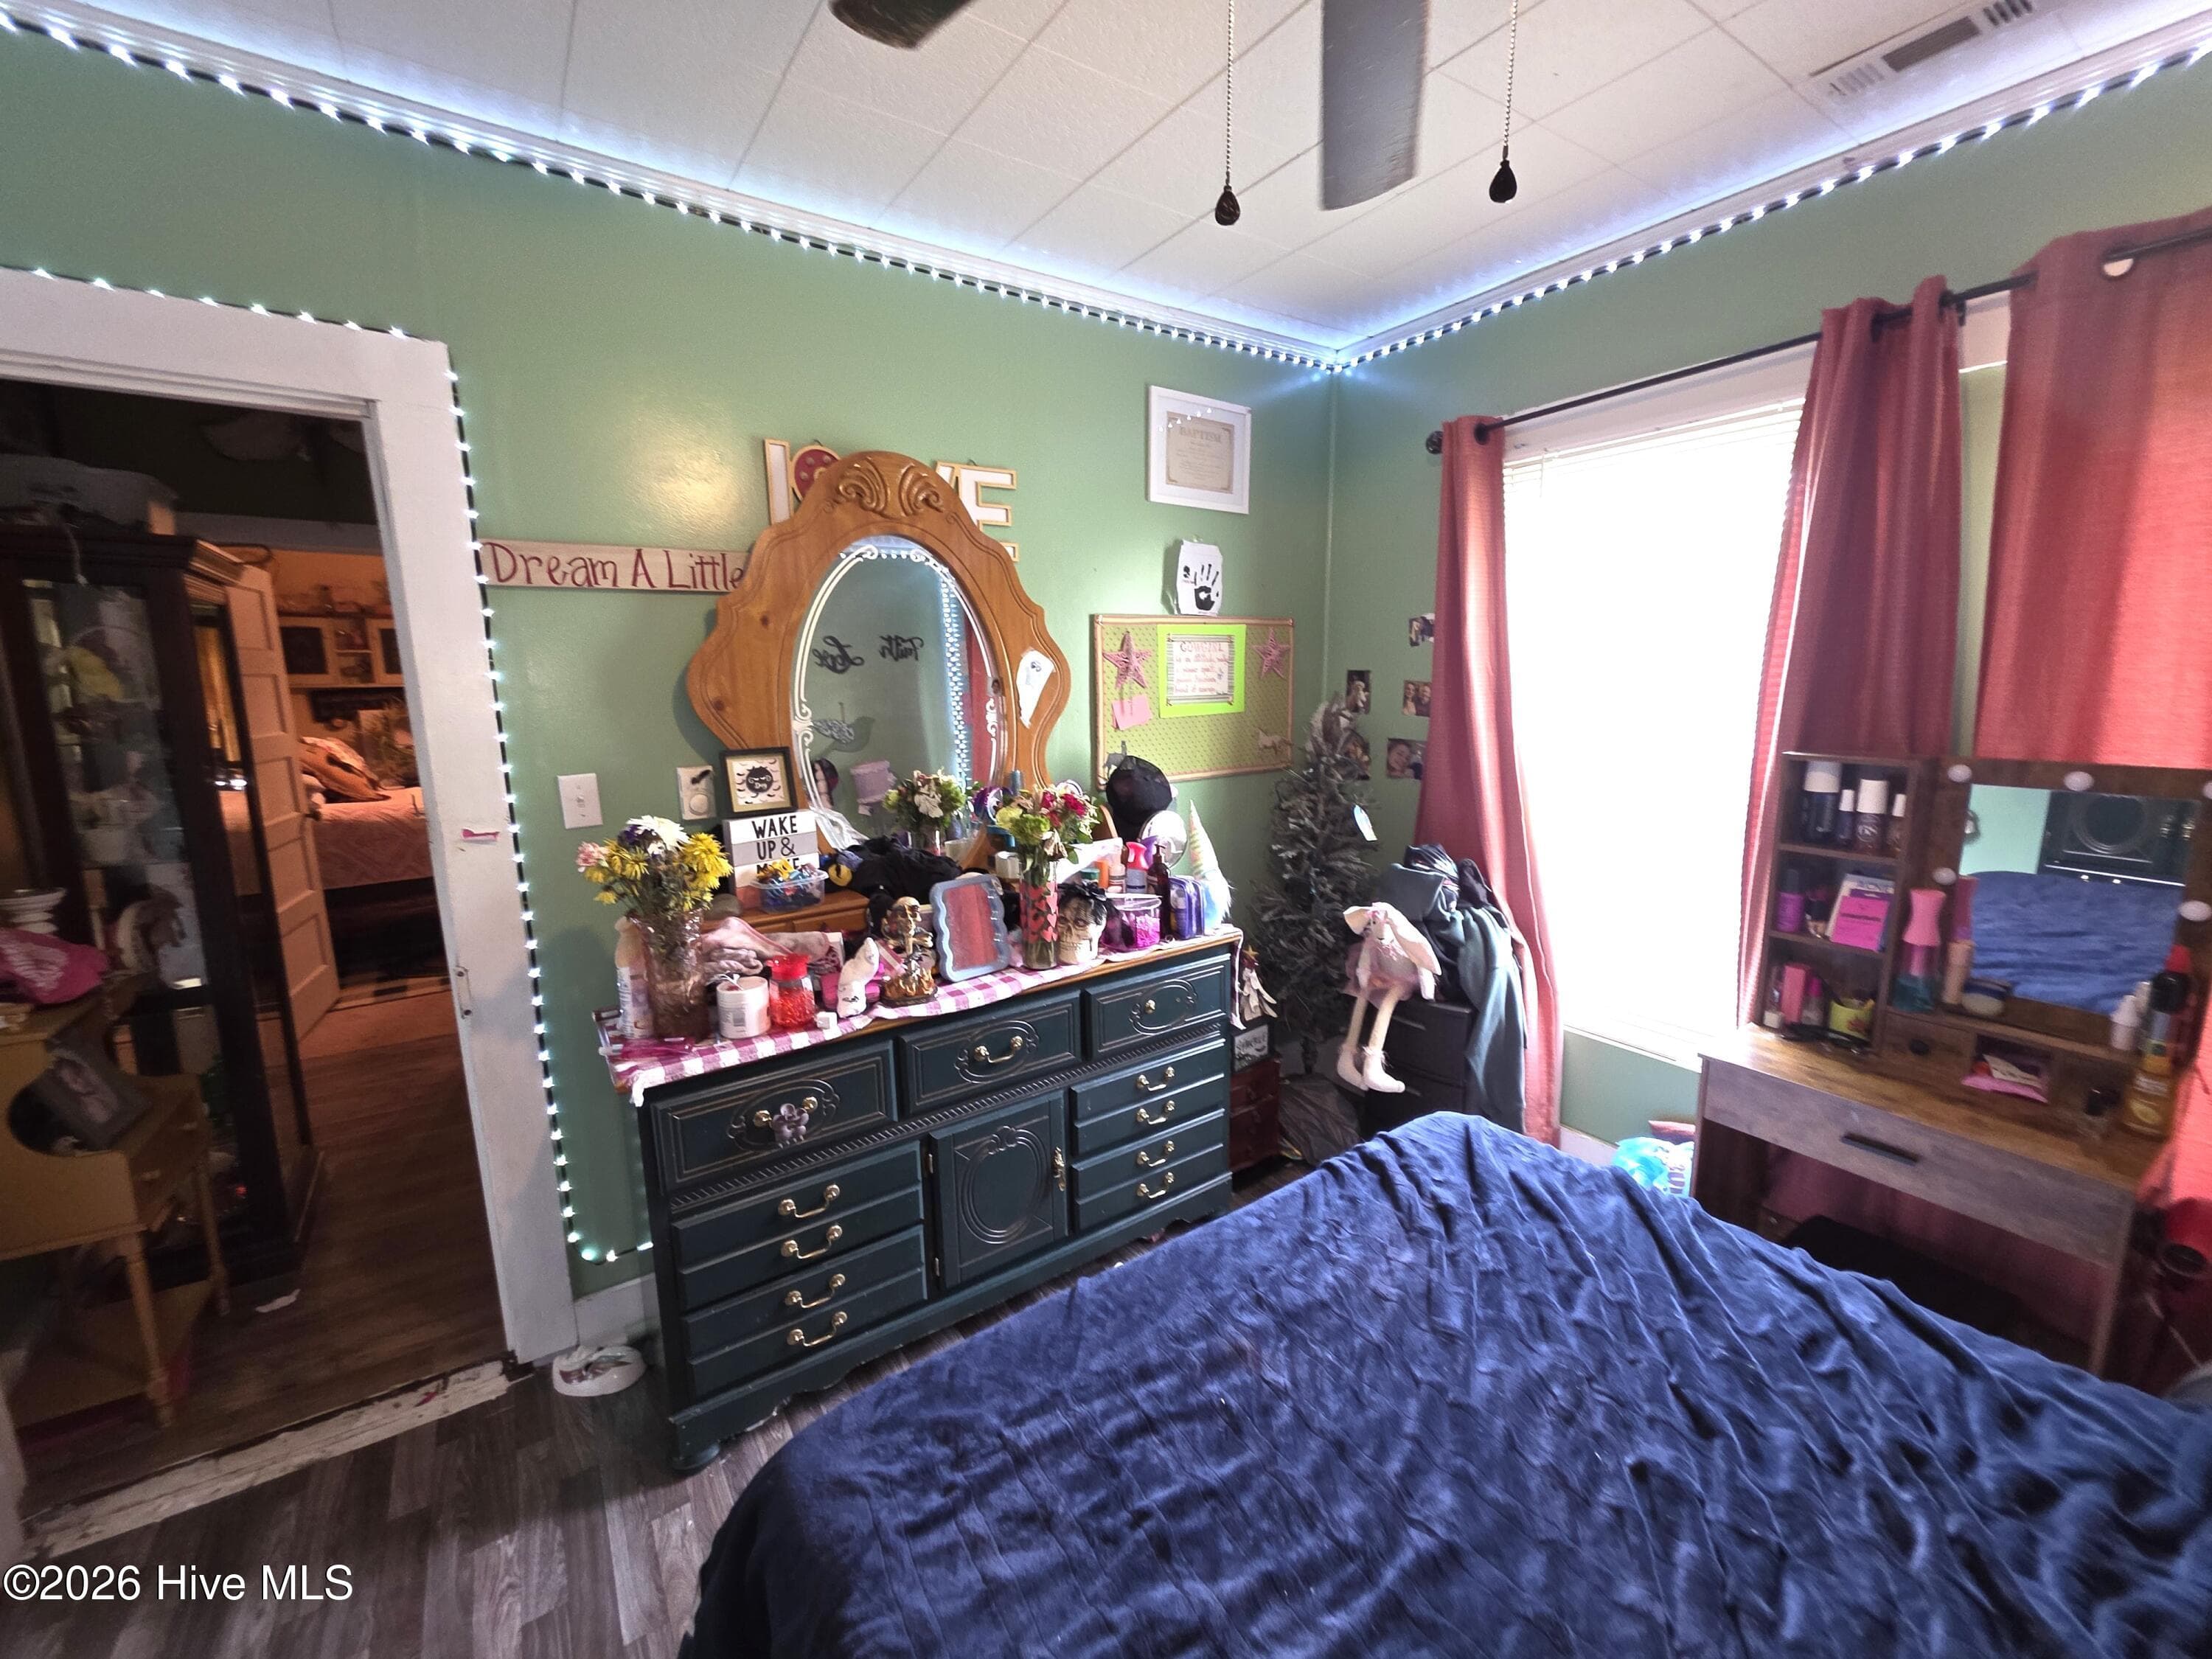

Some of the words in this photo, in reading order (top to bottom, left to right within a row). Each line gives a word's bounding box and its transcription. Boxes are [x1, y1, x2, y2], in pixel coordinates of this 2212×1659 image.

[483, 541, 619, 588] Dream
[631, 548, 657, 588] A
[663, 549, 744, 591] Little
[751, 815, 798, 838] WAKE
[757, 841, 776, 860] UP
[781, 837, 796, 856] &
